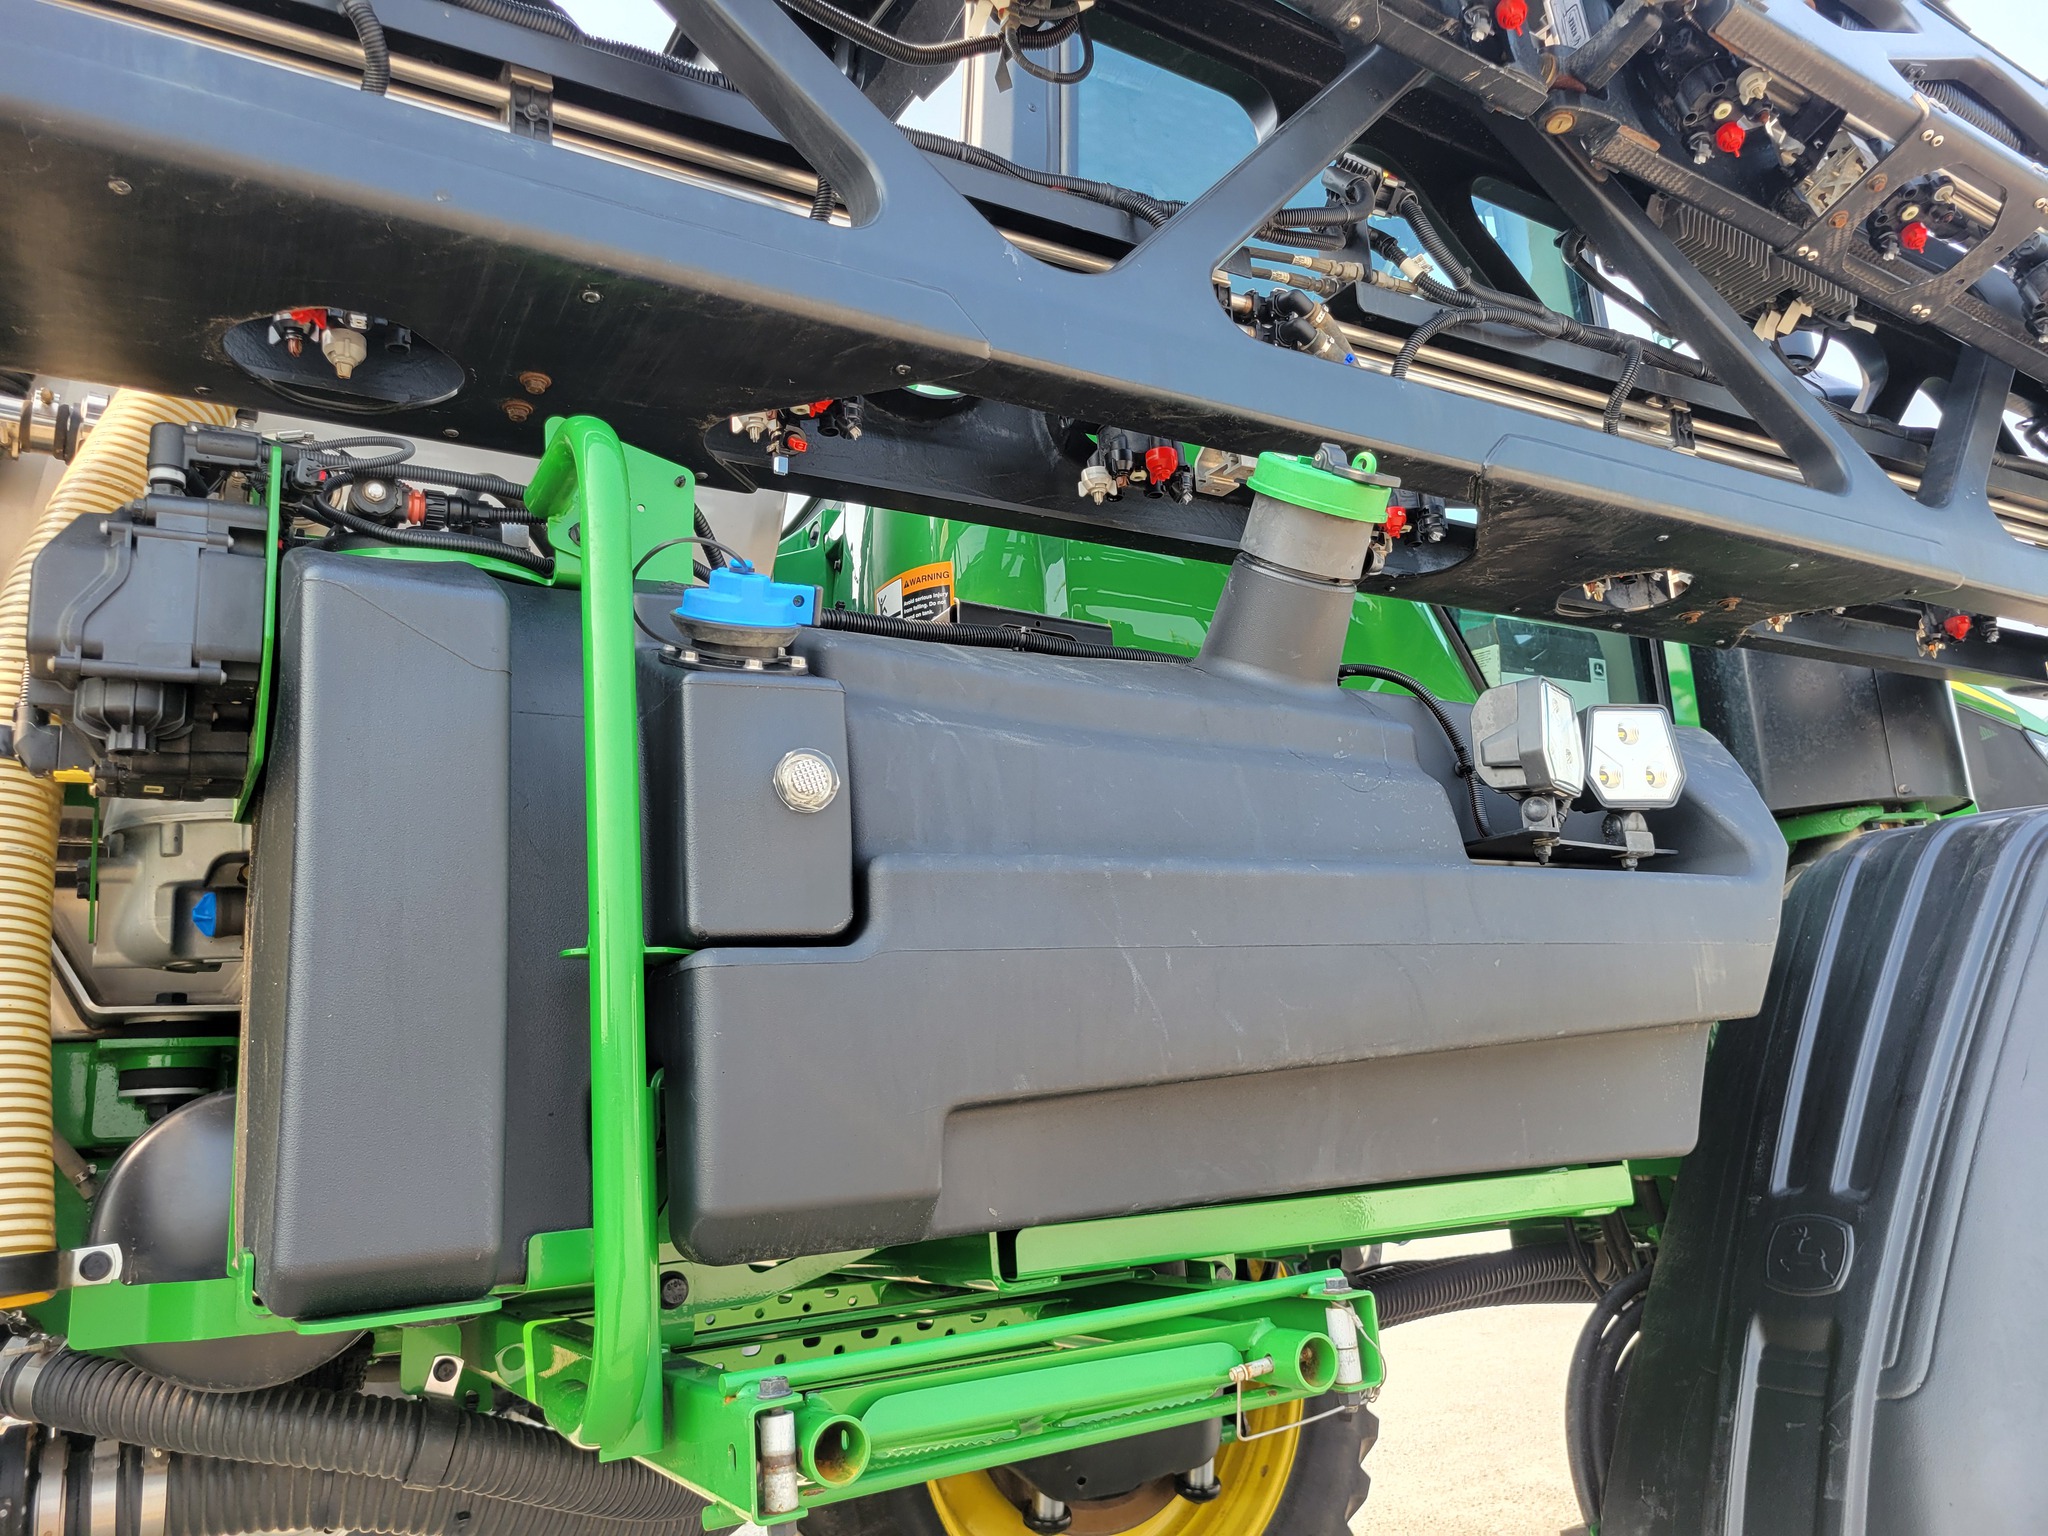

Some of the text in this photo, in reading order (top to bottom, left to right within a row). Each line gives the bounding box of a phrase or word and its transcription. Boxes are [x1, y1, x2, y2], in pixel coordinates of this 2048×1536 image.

[909, 571, 950, 586] WARNING
[915, 594, 933, 603] serious
[933, 591, 949, 600] injury
